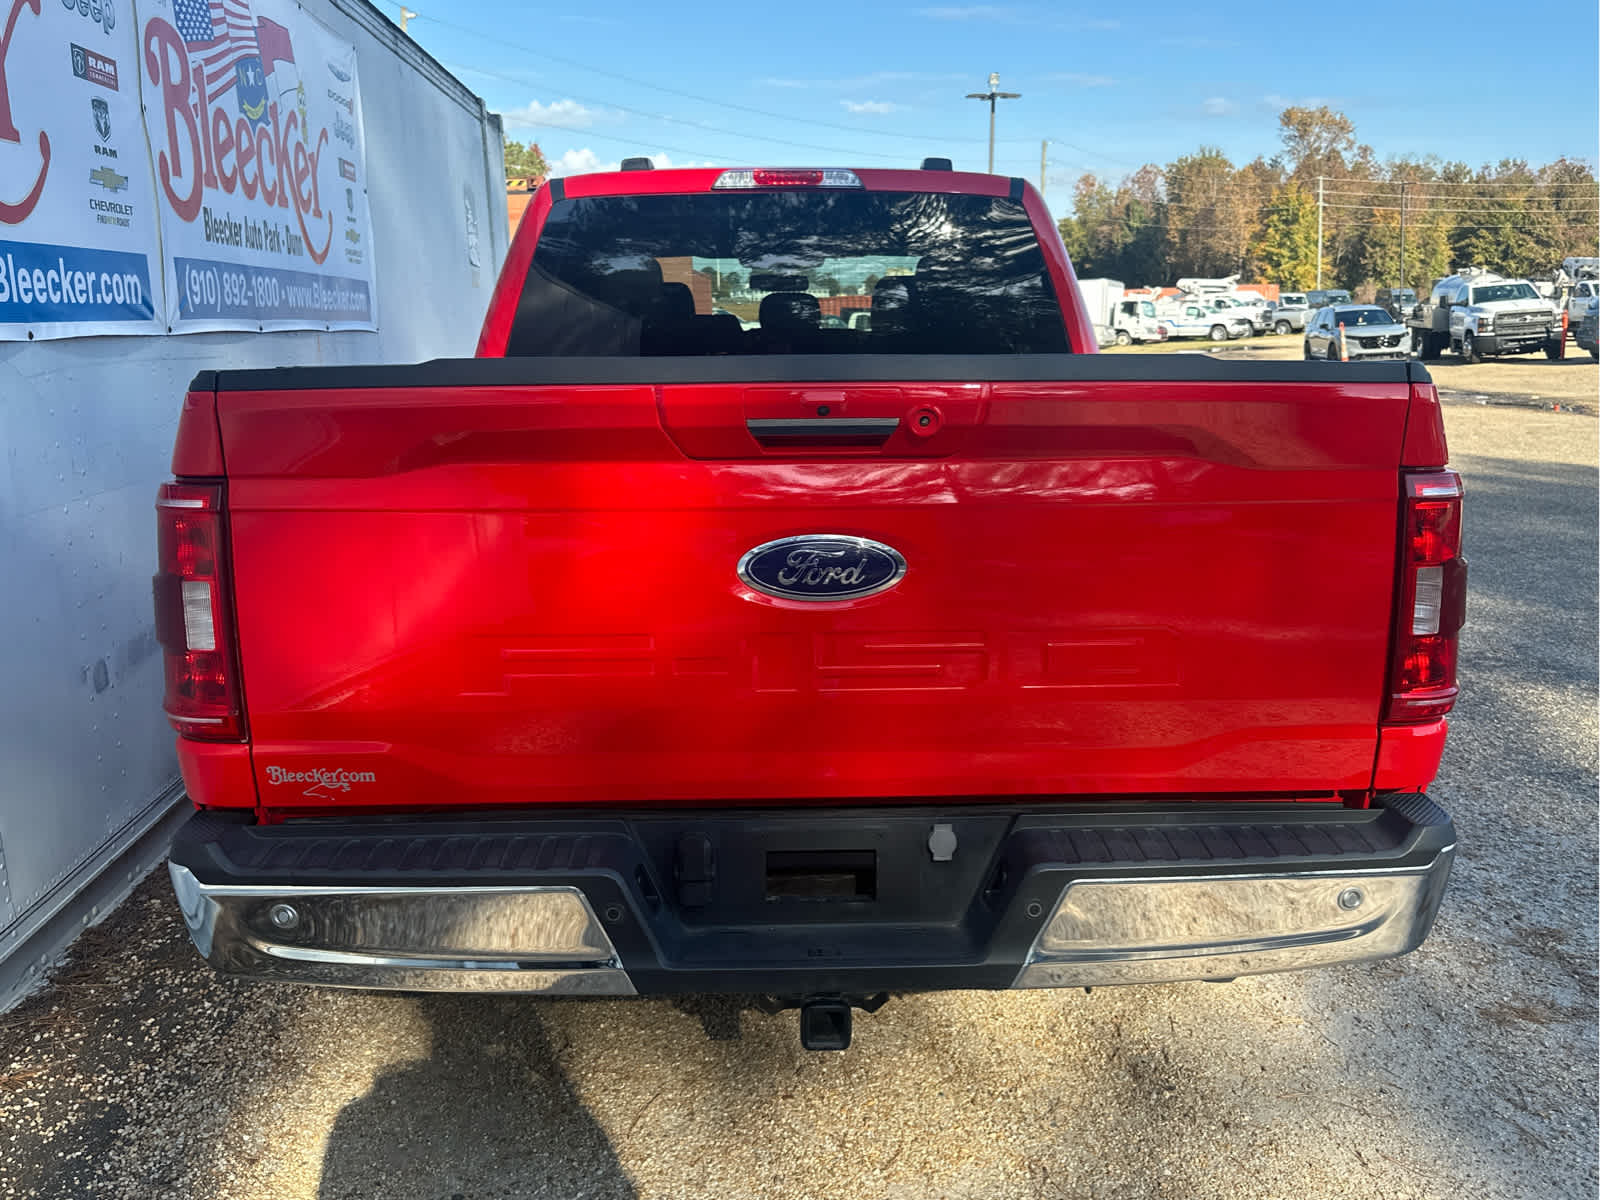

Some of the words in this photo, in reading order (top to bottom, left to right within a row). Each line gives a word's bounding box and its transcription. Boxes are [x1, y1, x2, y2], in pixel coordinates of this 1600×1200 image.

[62, 0, 115, 35] eep
[88, 55, 115, 76] RAM
[94, 144, 118, 159] RAM
[144, 17, 334, 265] Bleecker
[89, 198, 134, 217] CHEVROLET
[203, 206, 242, 247] Bleecker
[245, 215, 263, 251] Auto
[263, 219, 282, 254] Park
[186, 264, 221, 312] (910)
[223, 271, 280, 307] 892-1800
[777, 549, 868, 586] Ford
